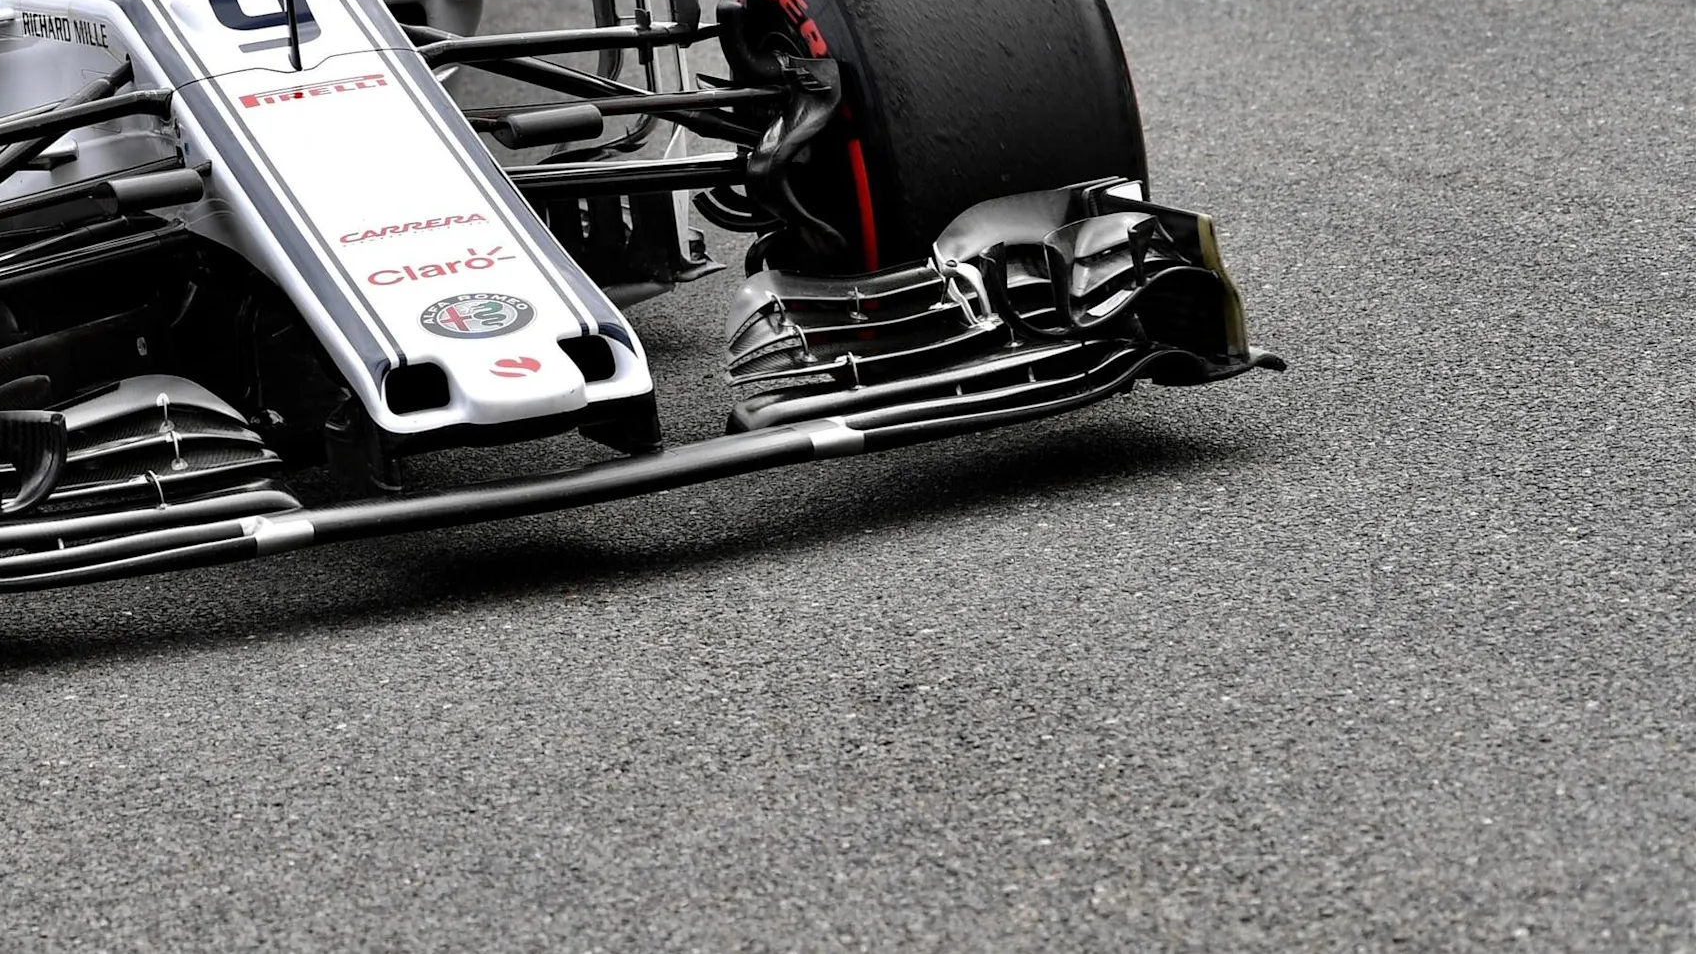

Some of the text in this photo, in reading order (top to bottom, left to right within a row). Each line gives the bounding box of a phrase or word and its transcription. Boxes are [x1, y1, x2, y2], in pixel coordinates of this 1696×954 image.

[22, 11, 109, 49] RICHARD MILLE
[238, 73, 388, 109] PIRELLI
[339, 212, 488, 244] CARRERA
[367, 249, 509, 286] Claro
[422, 292, 531, 326] ALFA ROMEO
